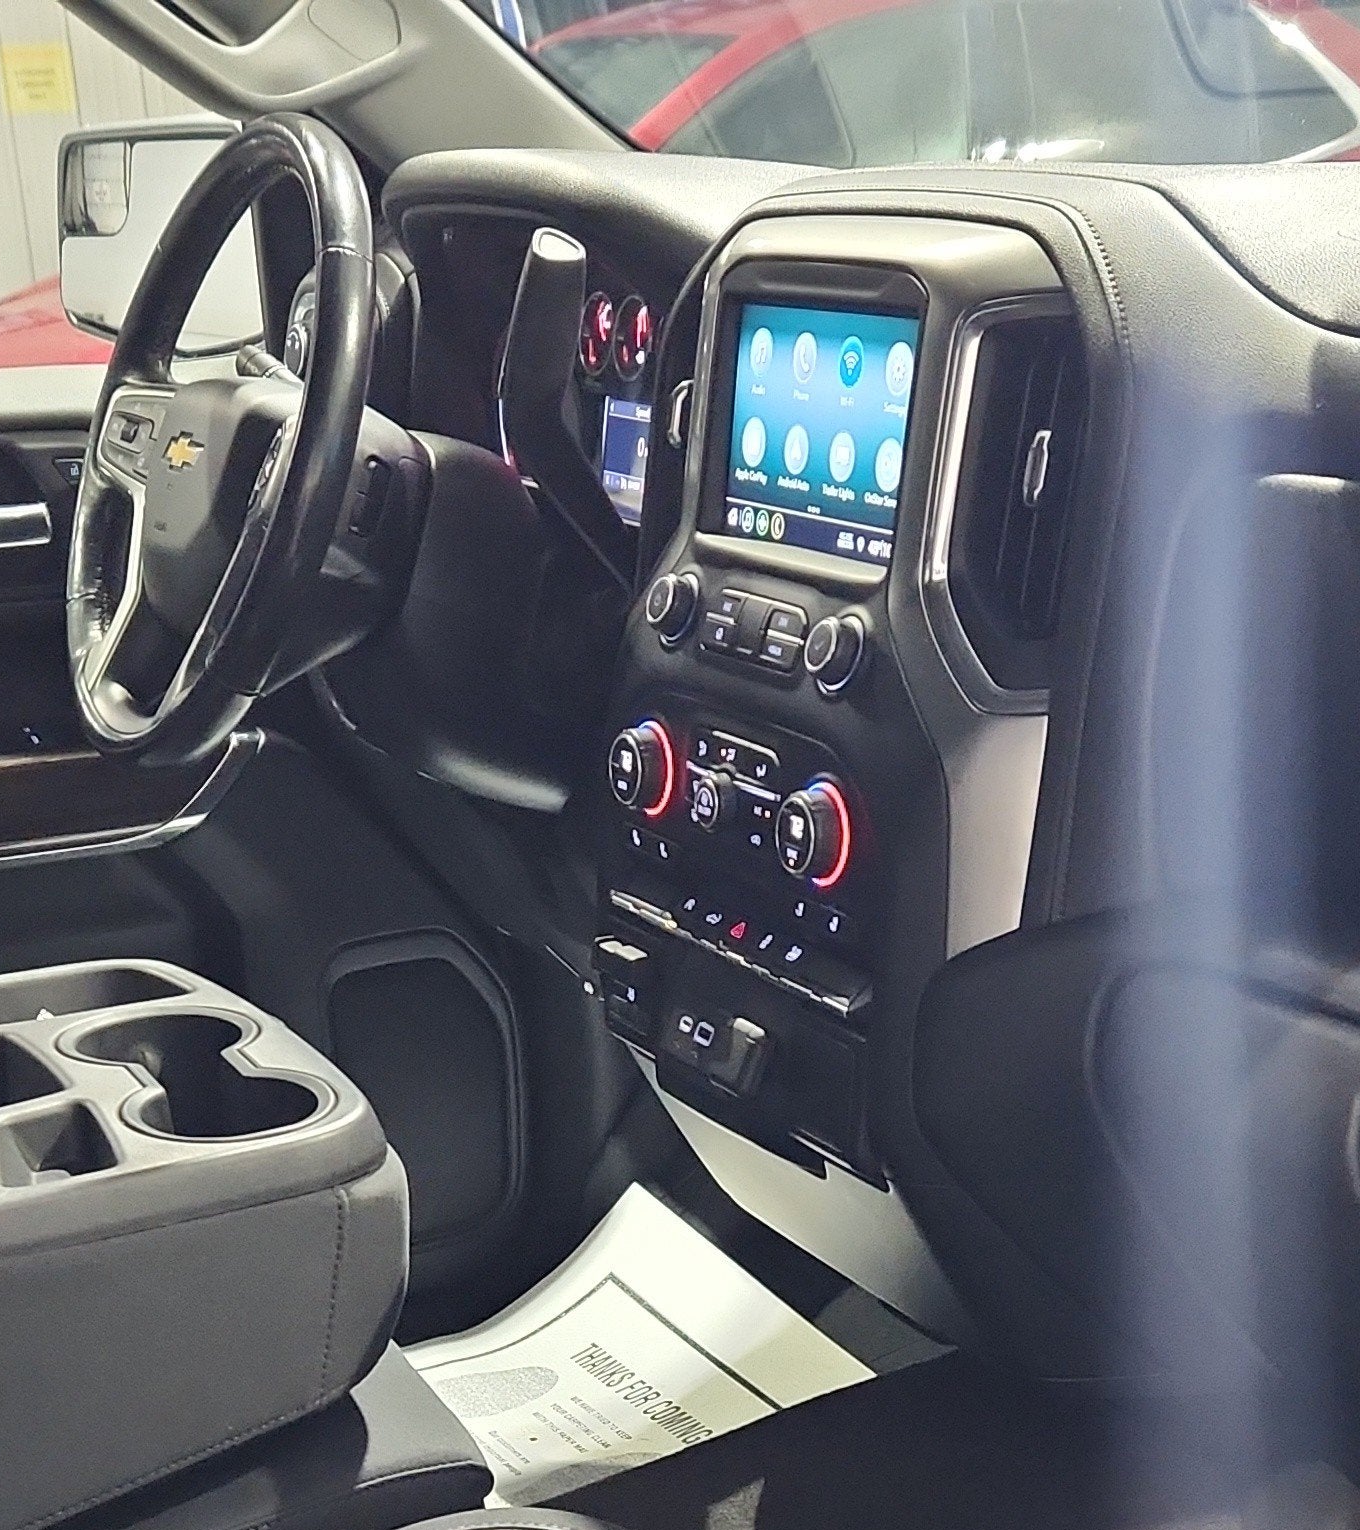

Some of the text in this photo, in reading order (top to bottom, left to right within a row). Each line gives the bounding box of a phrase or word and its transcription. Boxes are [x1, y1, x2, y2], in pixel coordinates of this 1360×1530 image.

[570, 1342, 714, 1445] THANKS FOR COMING
[615, 1429, 633, 1440] KEEP
